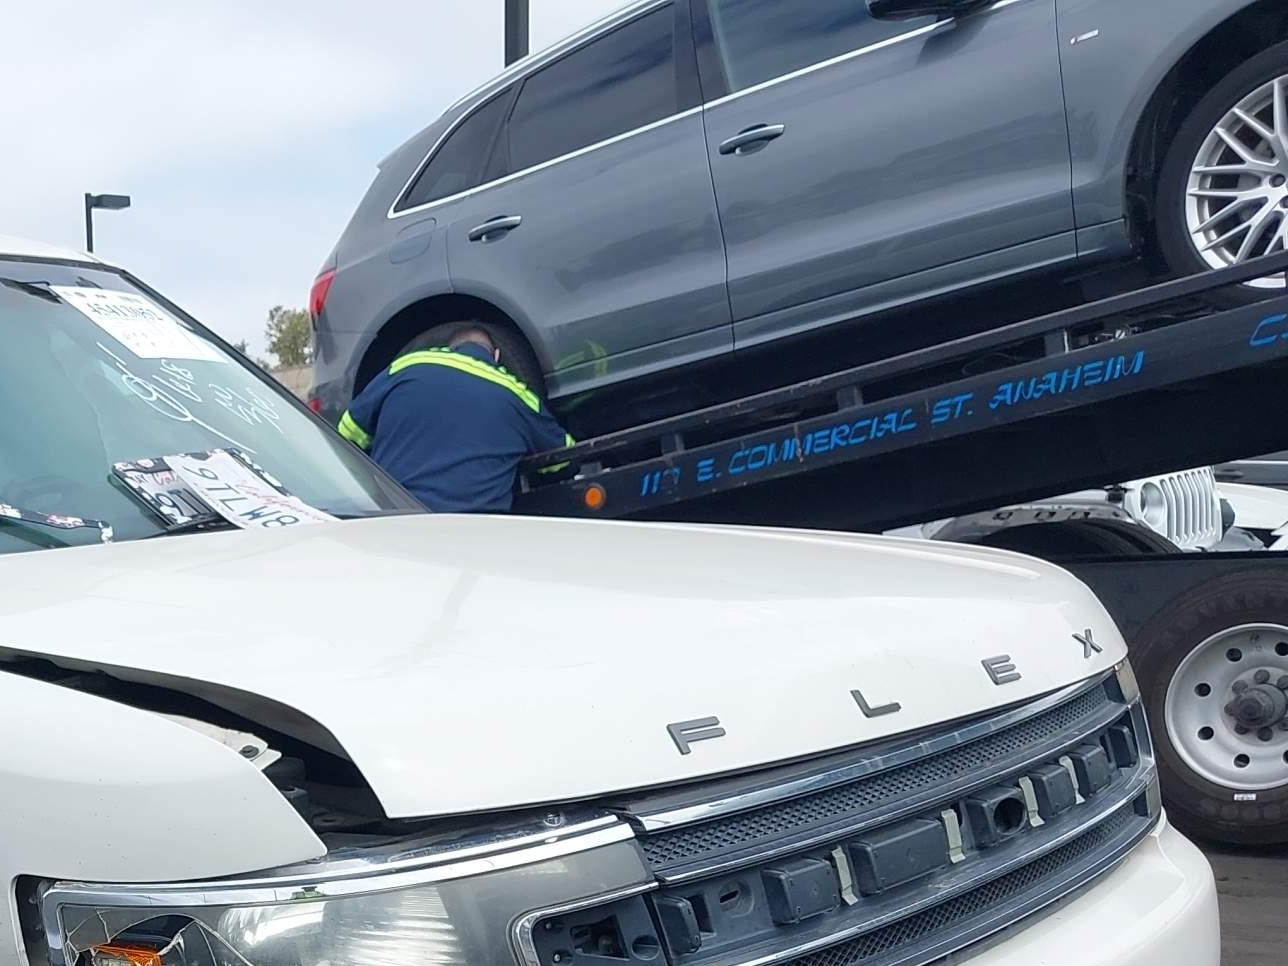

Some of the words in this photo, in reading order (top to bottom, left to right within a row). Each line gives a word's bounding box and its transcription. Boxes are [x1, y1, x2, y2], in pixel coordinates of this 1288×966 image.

[696, 458, 723, 482] E.
[728, 408, 917, 475] COMMERCIAL
[930, 392, 975, 425] ST.
[988, 351, 1145, 409] ANAHEIM
[666, 628, 1104, 755] FLEX
